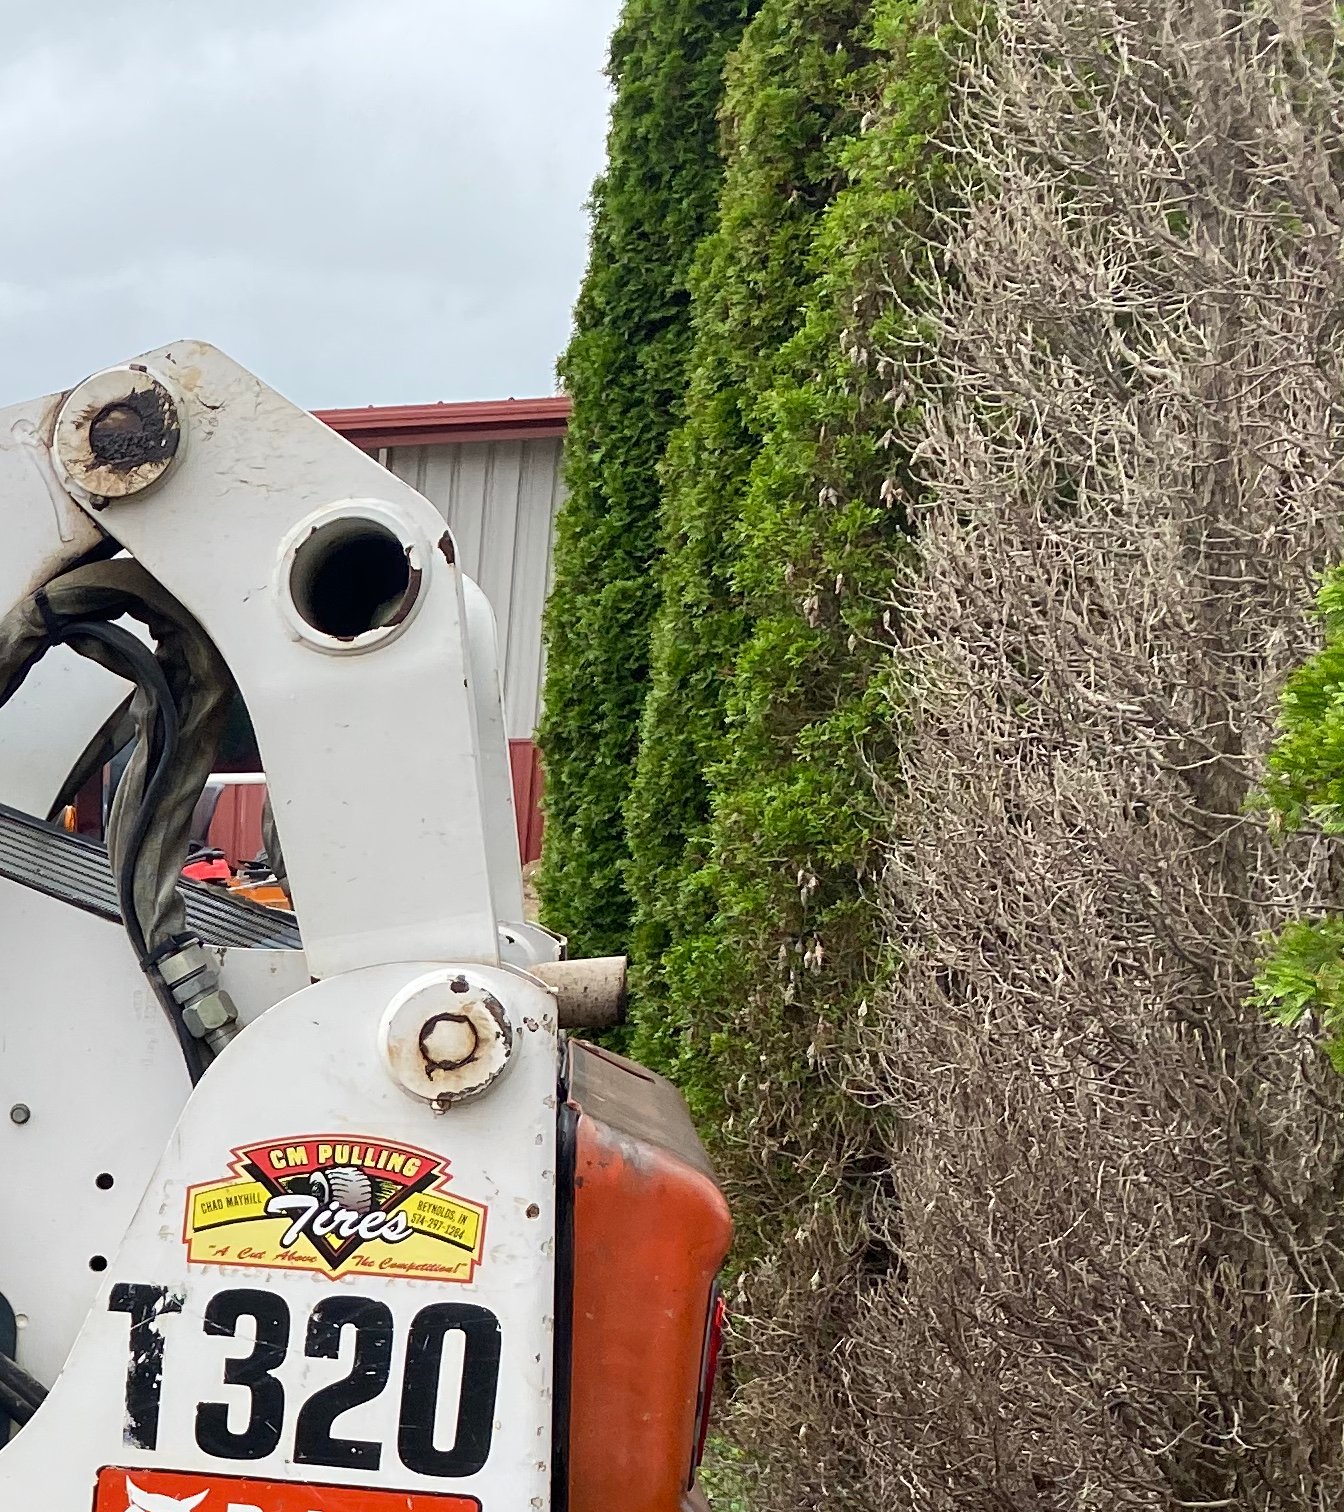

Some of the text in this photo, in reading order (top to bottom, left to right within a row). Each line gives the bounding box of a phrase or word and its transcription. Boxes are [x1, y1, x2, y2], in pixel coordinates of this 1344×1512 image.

[269, 1144, 422, 1178] CM PULLING
[200, 1198, 223, 1214] CHAD
[265, 1193, 413, 1248] Tires
[237, 1247, 266, 1260] Cut
[274, 1249, 318, 1263] Above
[352, 1255, 375, 1267] The
[107, 1283, 502, 1478] T320
